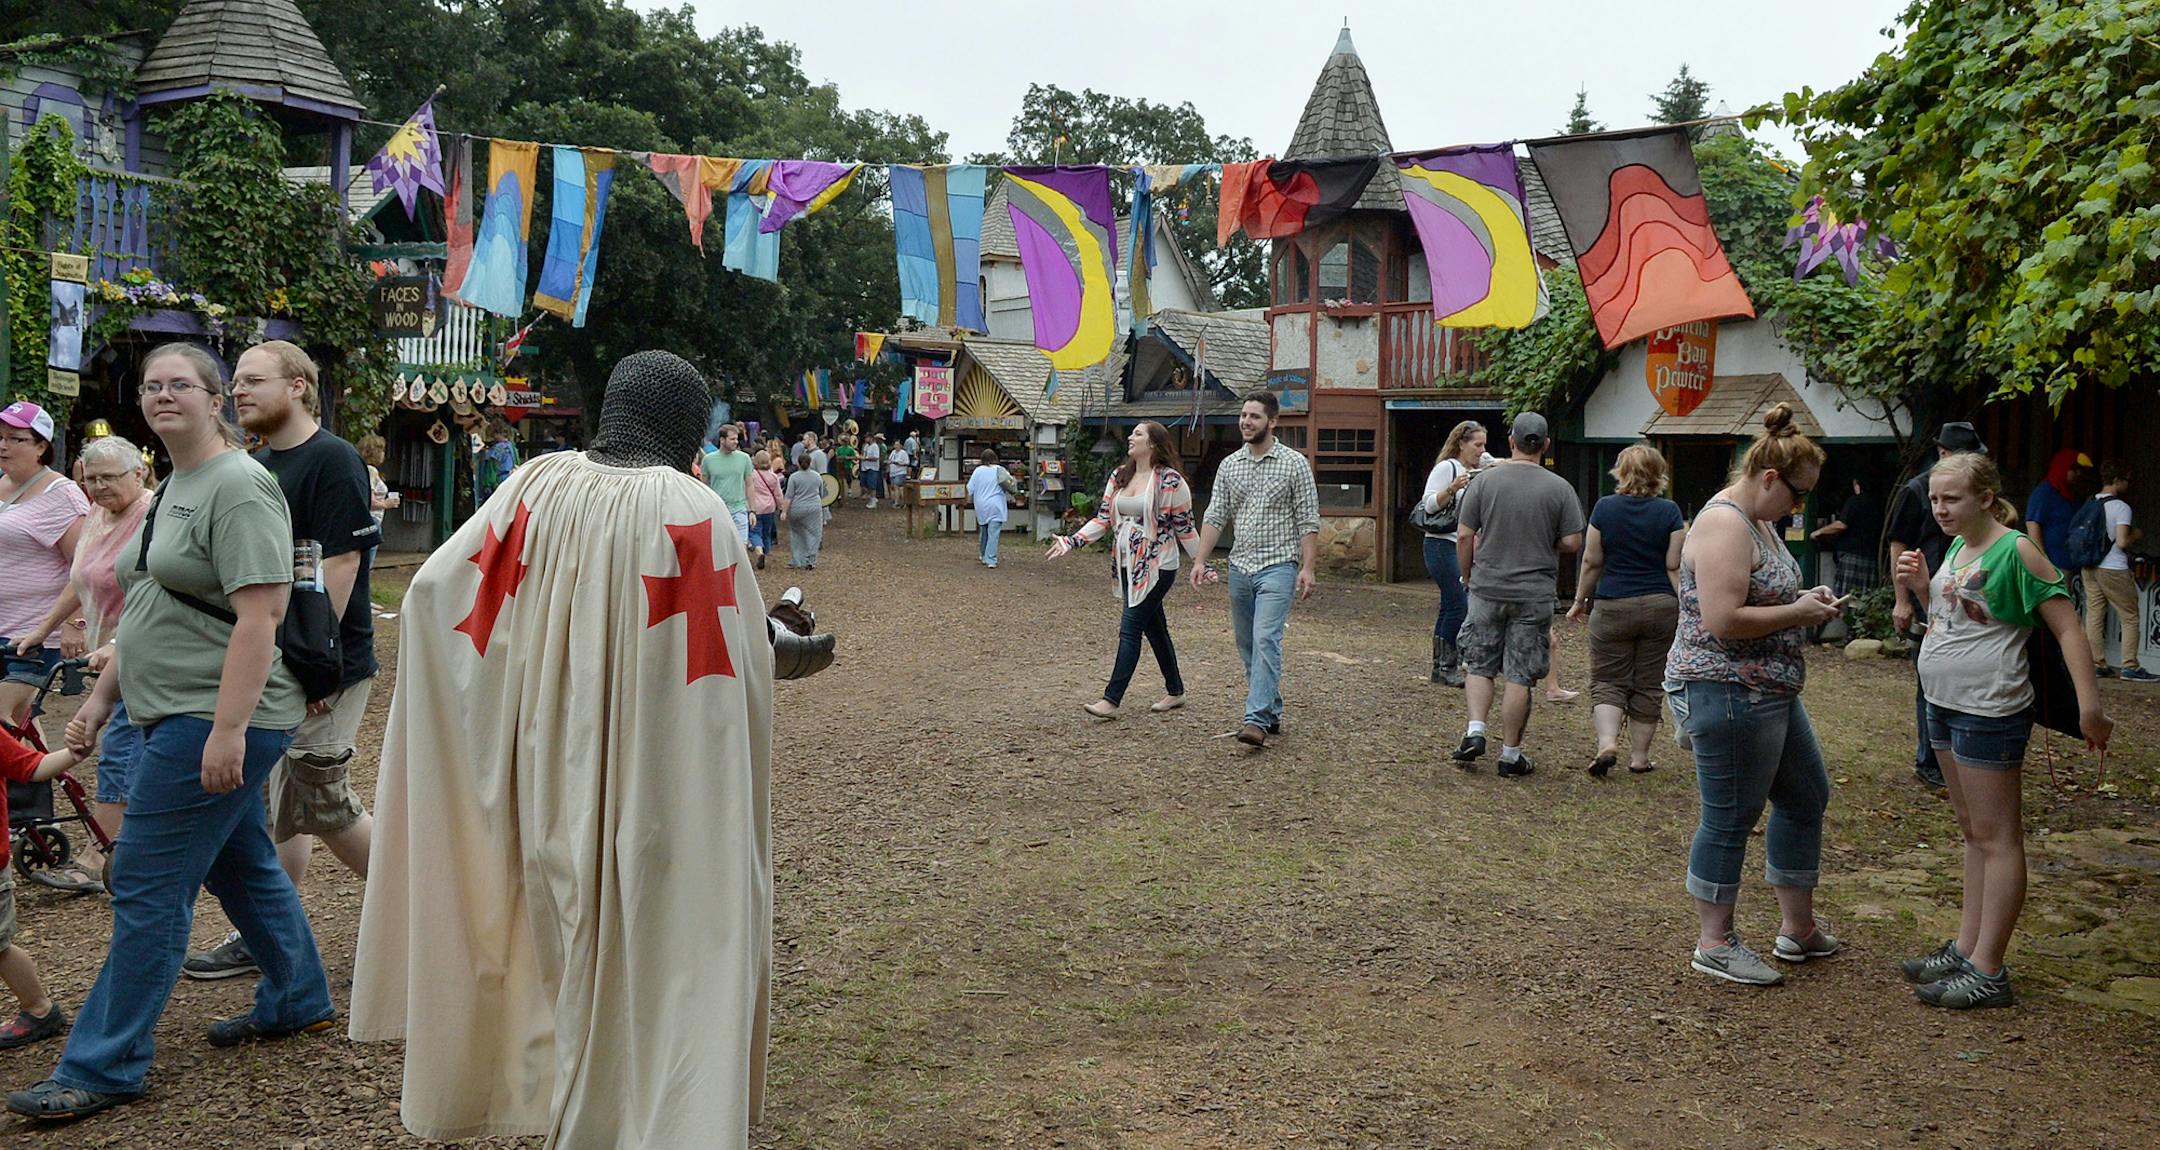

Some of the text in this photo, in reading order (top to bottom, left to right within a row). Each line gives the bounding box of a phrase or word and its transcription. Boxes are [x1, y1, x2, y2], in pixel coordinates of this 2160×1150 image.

[381, 286, 420, 302] FACES
[396, 303, 404, 312] IN
[385, 312, 419, 328] WOOD
[1676, 339, 1708, 371] Bay
[1656, 364, 1706, 396] Pewter
